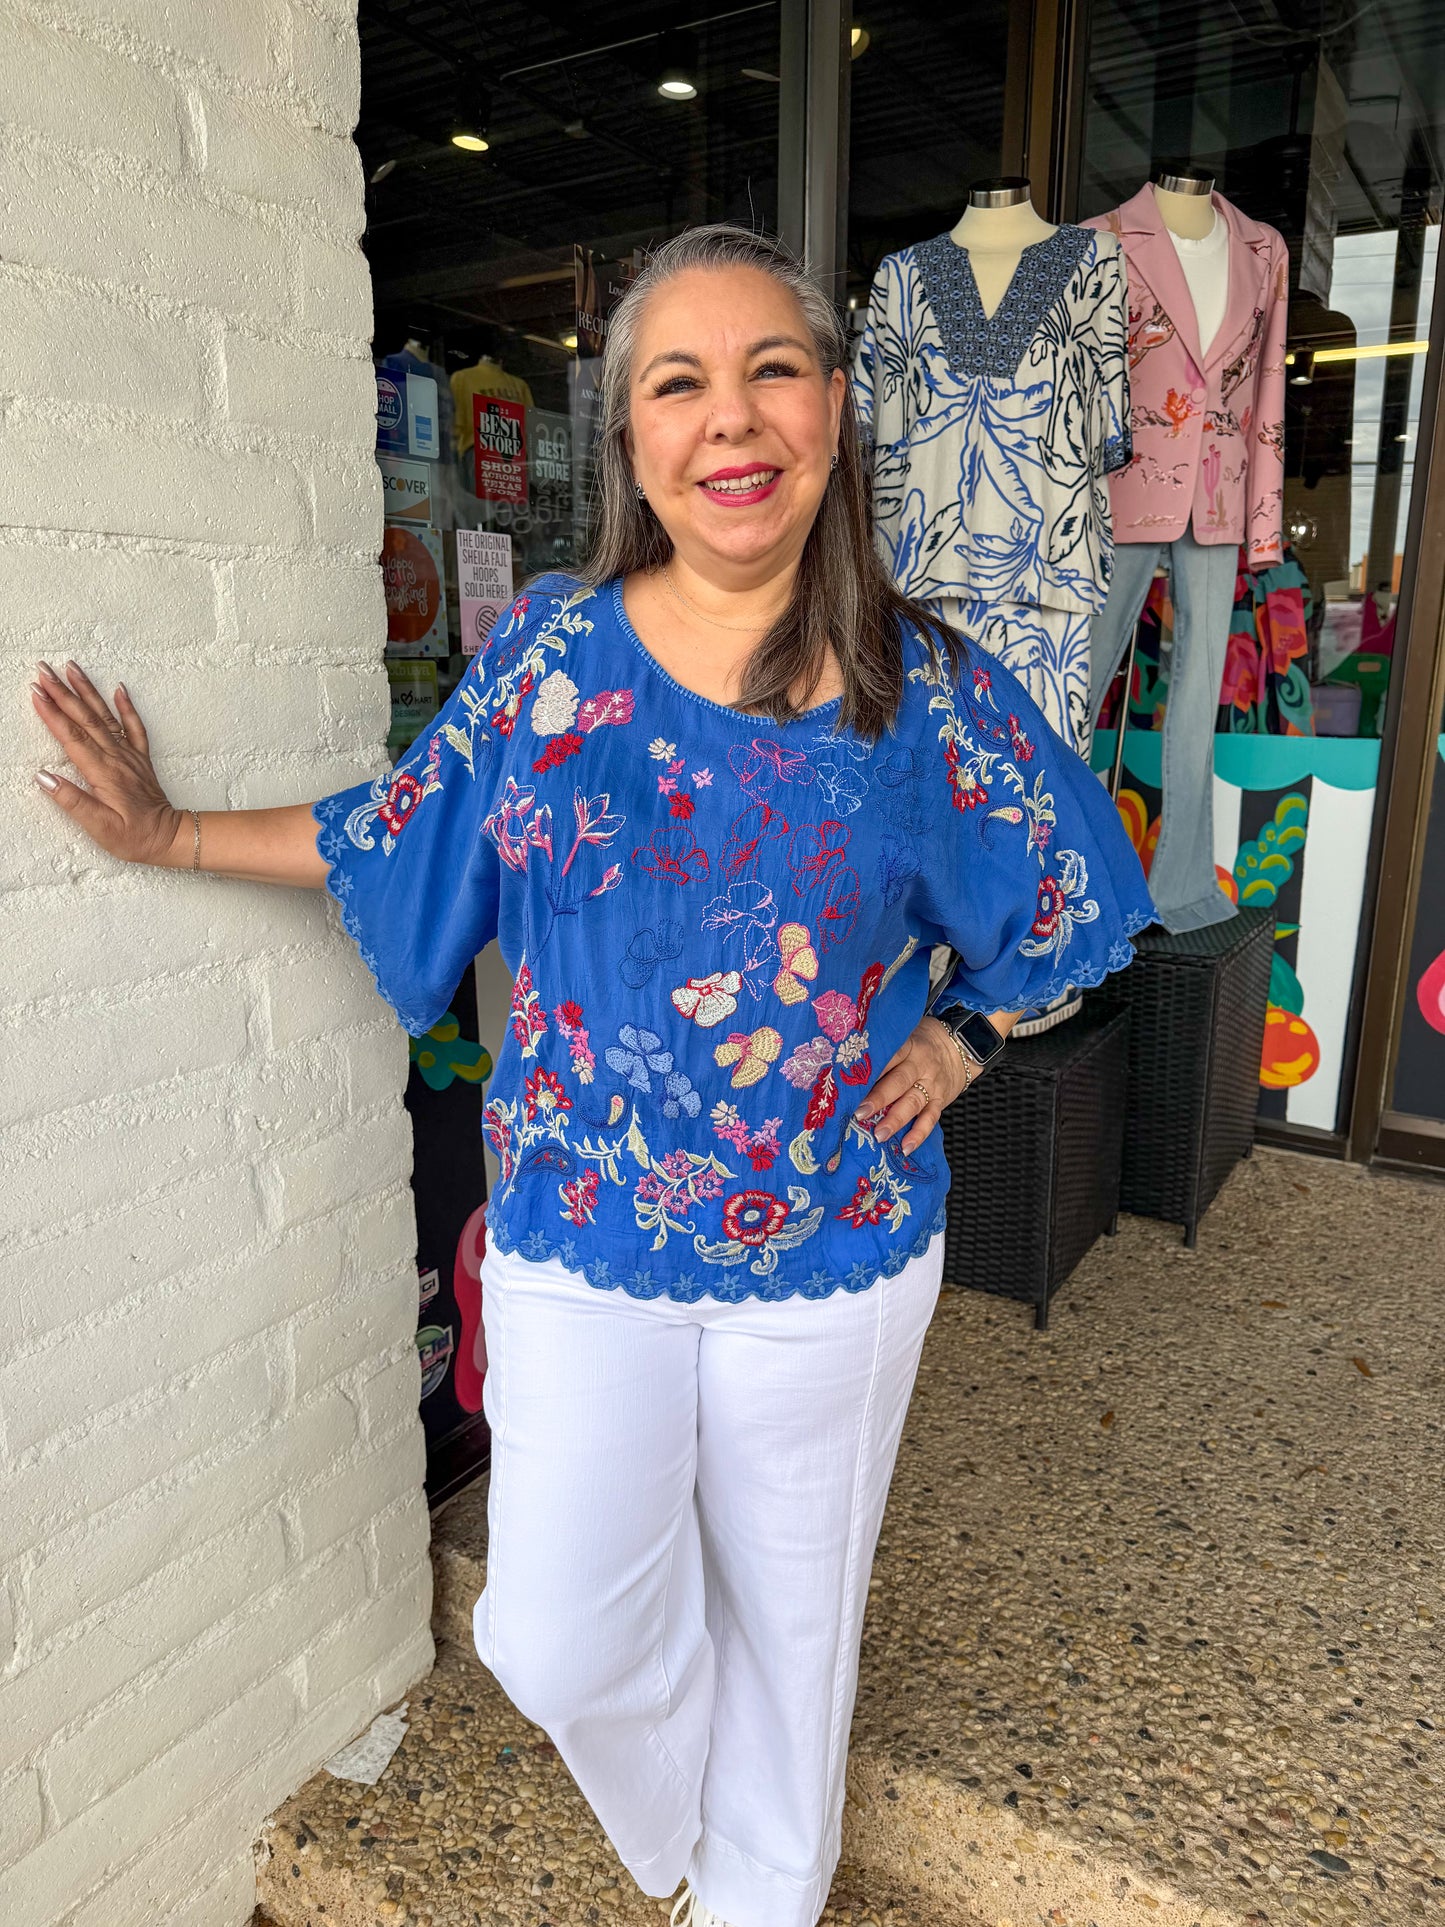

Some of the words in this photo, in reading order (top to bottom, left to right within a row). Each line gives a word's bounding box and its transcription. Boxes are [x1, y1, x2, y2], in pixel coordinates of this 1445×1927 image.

[378, 393, 395, 404] HOP
[378, 403, 397, 415] MALL
[479, 411, 520, 440] BEST
[479, 434, 521, 457] STORE
[537, 439, 565, 461] BEST
[480, 460, 522, 475] SHOP
[535, 459, 570, 482] STORE
[382, 475, 427, 495] SCOVER
[481, 471, 522, 483] ACROSS
[481, 479, 522, 492] TEXAS
[458, 531, 473, 548] THE
[474, 533, 510, 552] ORIGINAL
[462, 548, 490, 566] SHEILA
[491, 551, 508, 568] FAJL
[472, 566, 499, 583] HOOPS
[464, 582, 485, 598] SOLD
[486, 583, 508, 599] HERE!
[389, 666, 406, 676] OLD
[407, 666, 431, 676] LEVEL
[414, 696, 433, 705] HART
[394, 709, 421, 718] DESIGN
